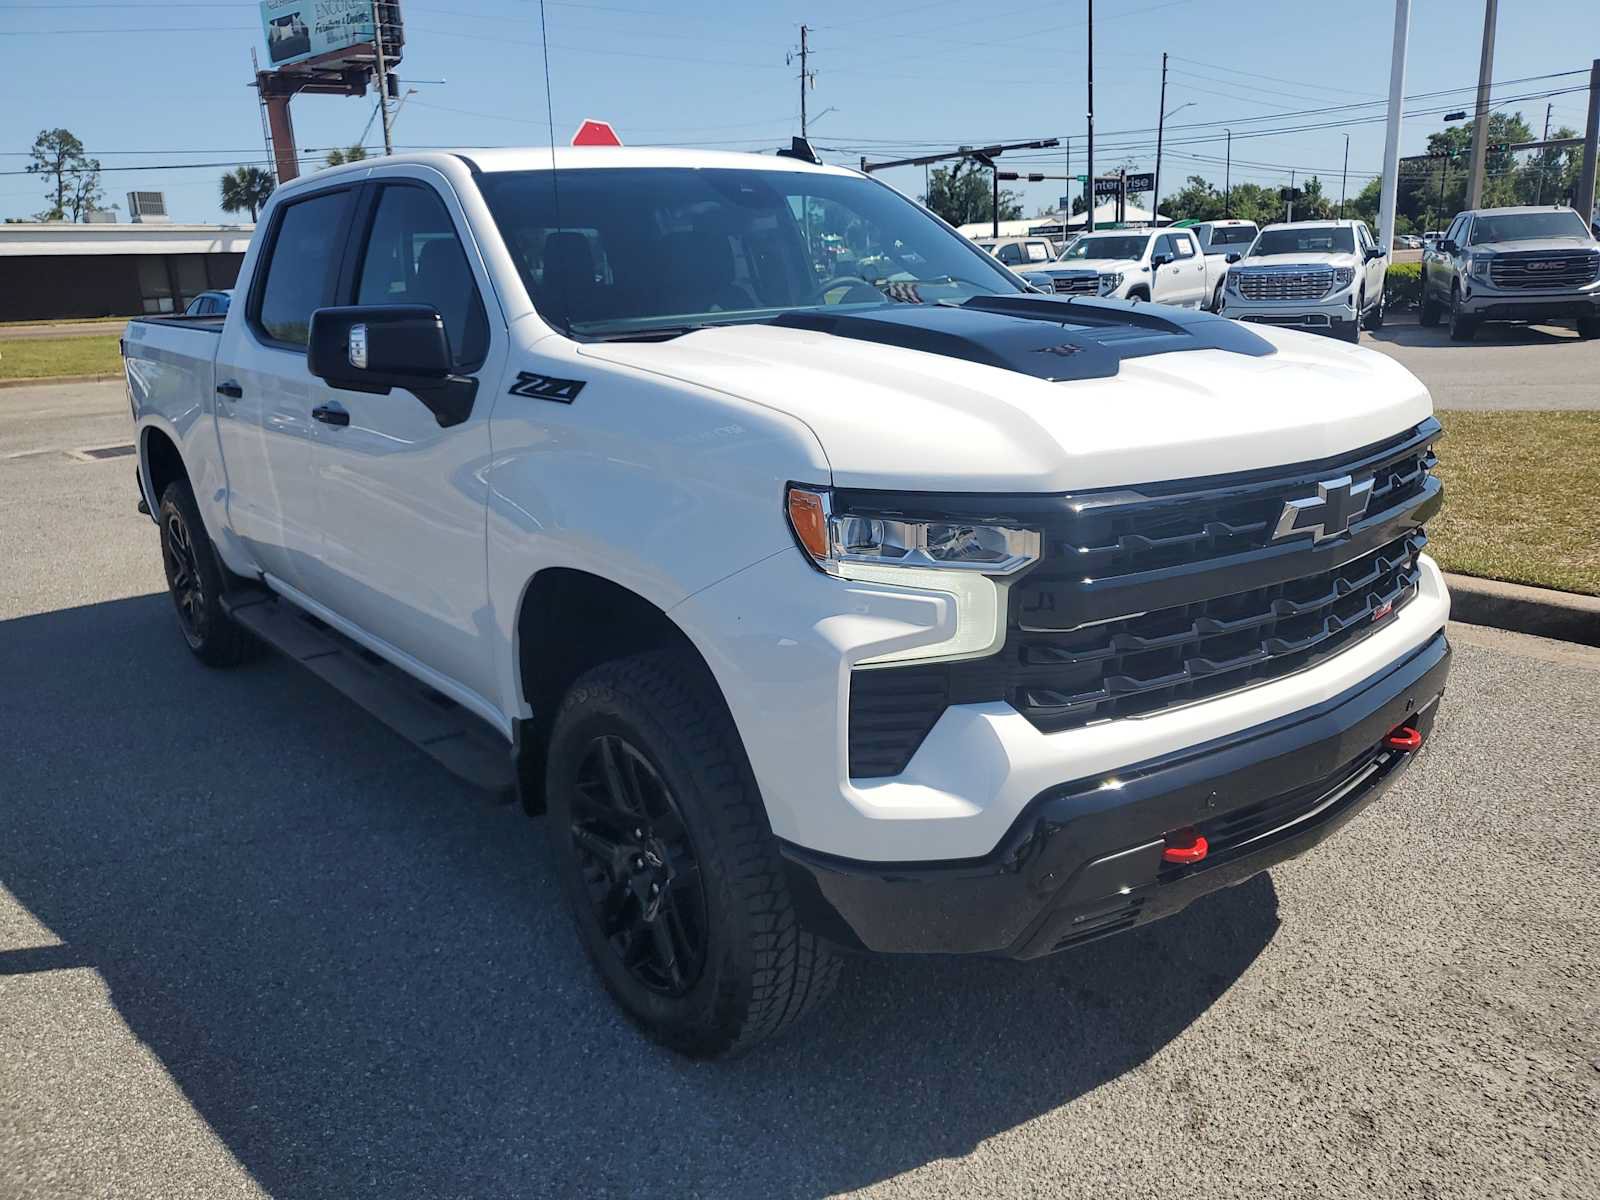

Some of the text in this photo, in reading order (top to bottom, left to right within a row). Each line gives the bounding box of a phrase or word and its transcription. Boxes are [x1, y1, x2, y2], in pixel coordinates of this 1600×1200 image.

[1095, 177, 1149, 191] nterrise
[1528, 261, 1567, 270] GMC
[1055, 279, 1073, 287] MC
